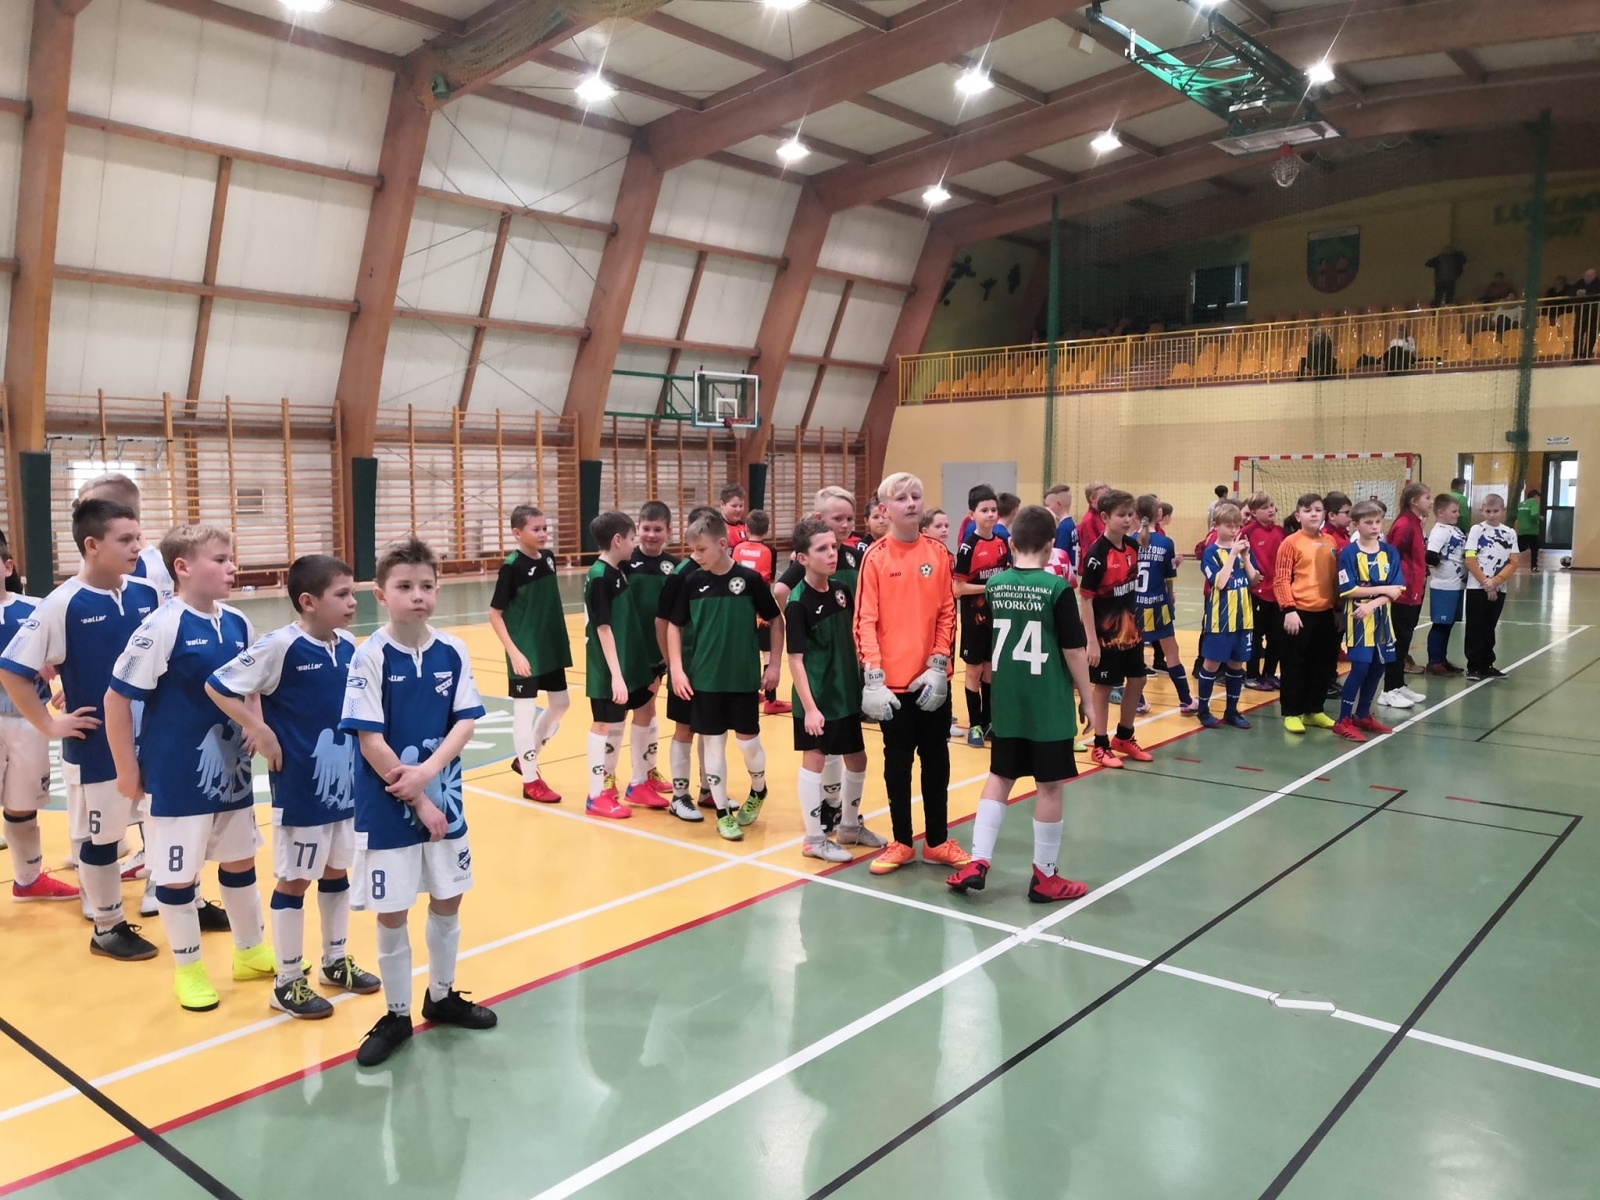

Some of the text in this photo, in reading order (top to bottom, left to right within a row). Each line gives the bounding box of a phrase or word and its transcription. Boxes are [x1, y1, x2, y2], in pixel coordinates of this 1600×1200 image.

[991, 618, 1050, 675] 74
[89, 810, 102, 835] 6
[168, 845, 184, 872] 8
[293, 841, 319, 869] 77
[371, 870, 386, 899] 8
